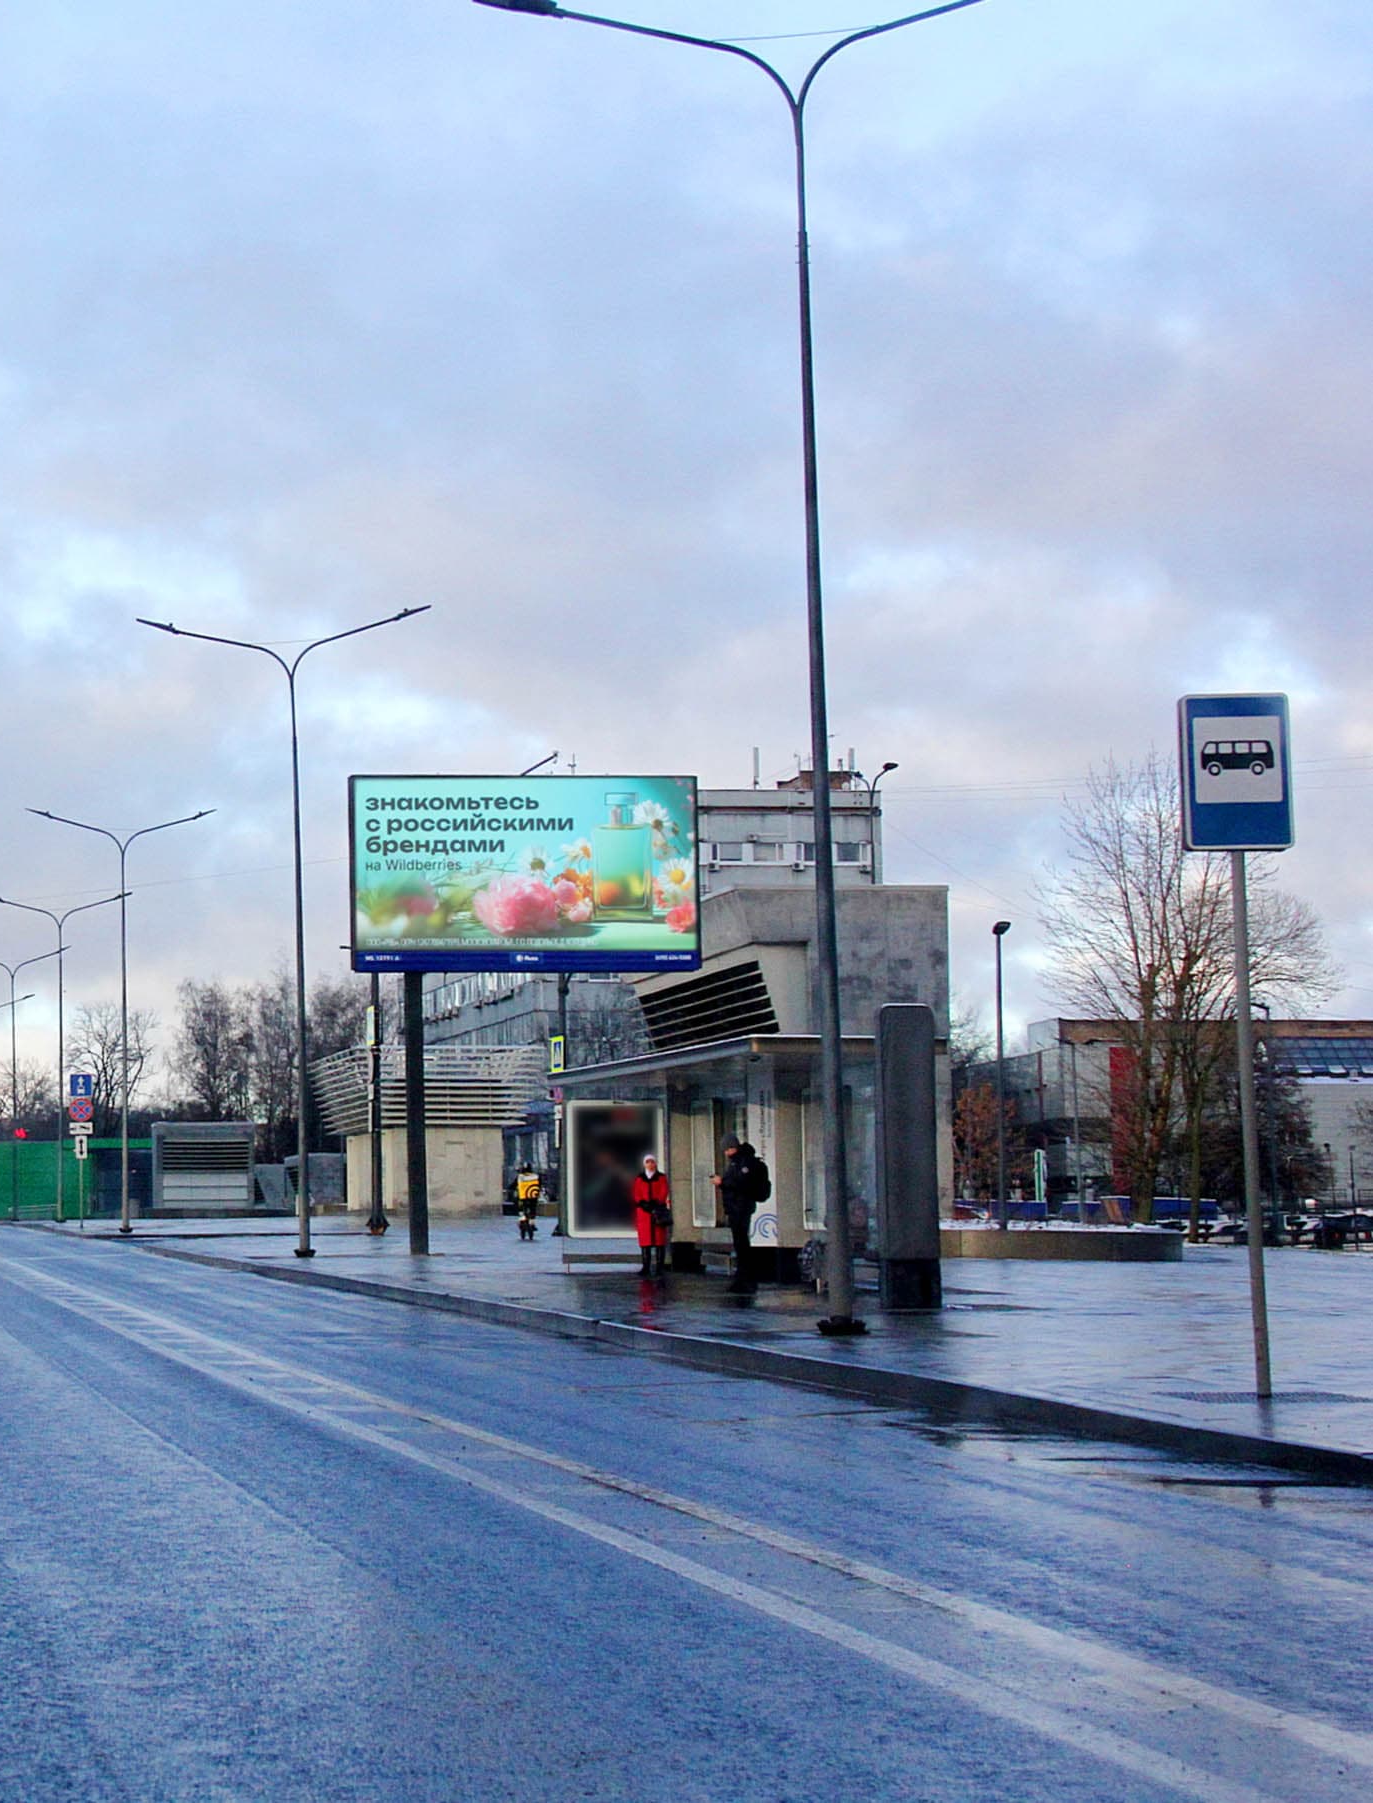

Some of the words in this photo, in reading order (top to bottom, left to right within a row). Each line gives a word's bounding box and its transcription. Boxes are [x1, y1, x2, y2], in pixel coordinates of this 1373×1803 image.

[365, 796, 540, 811] знакомьтесь
[365, 818, 381, 832] с
[386, 813, 574, 835] российскими
[365, 835, 506, 856] брендами
[365, 860, 382, 871] на
[385, 858, 463, 871] Wildberries
